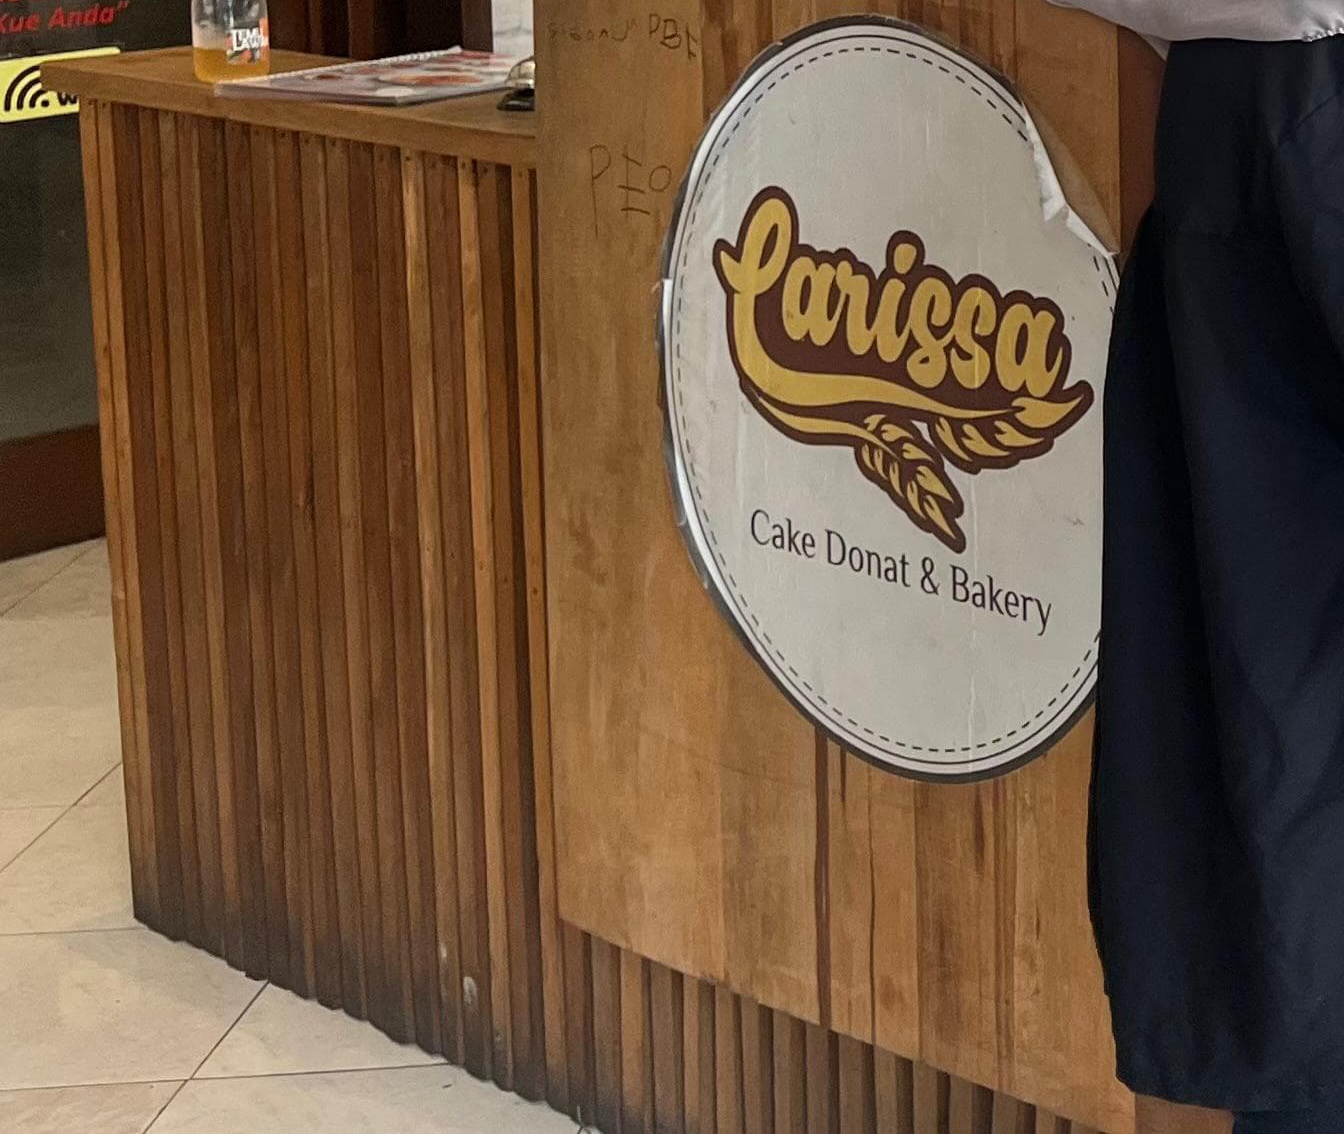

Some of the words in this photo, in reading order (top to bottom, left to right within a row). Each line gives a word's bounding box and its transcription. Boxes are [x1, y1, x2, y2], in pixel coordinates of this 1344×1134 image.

[714, 187, 1072, 436] Larissa
[749, 508, 817, 560] Cake
[825, 529, 912, 588] Donat
[920, 556, 940, 596] &
[949, 563, 1052, 637] Bakery
